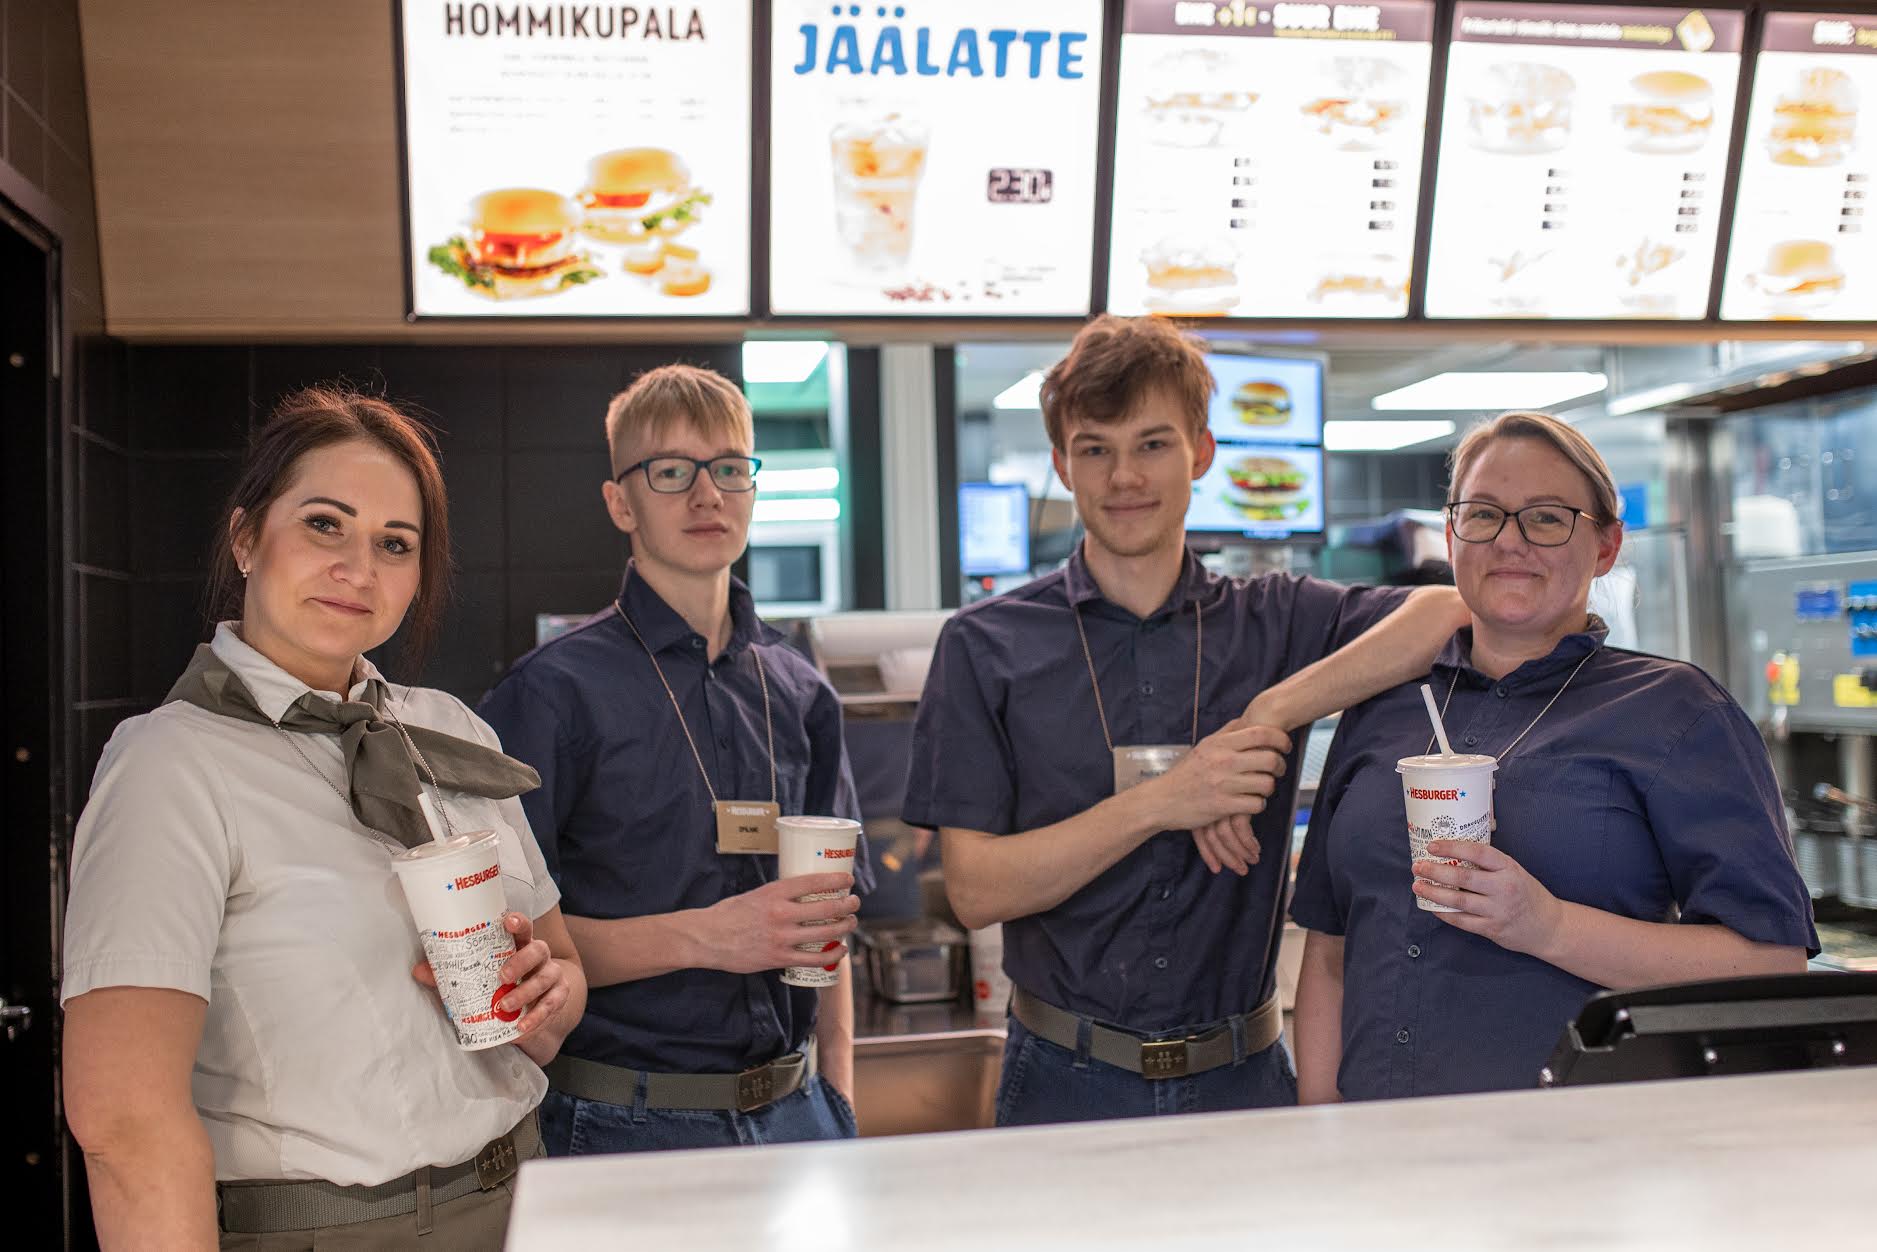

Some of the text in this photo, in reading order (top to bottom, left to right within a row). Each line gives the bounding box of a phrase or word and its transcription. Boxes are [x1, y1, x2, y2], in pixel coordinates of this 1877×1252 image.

[444, 2, 706, 40] HOMMIKUPALA
[794, 5, 1088, 79] JÄÄLATTE
[1410, 787, 1459, 801] HESBURGER
[455, 863, 500, 891] HESBURGE
[438, 922, 488, 939] HESBURGER
